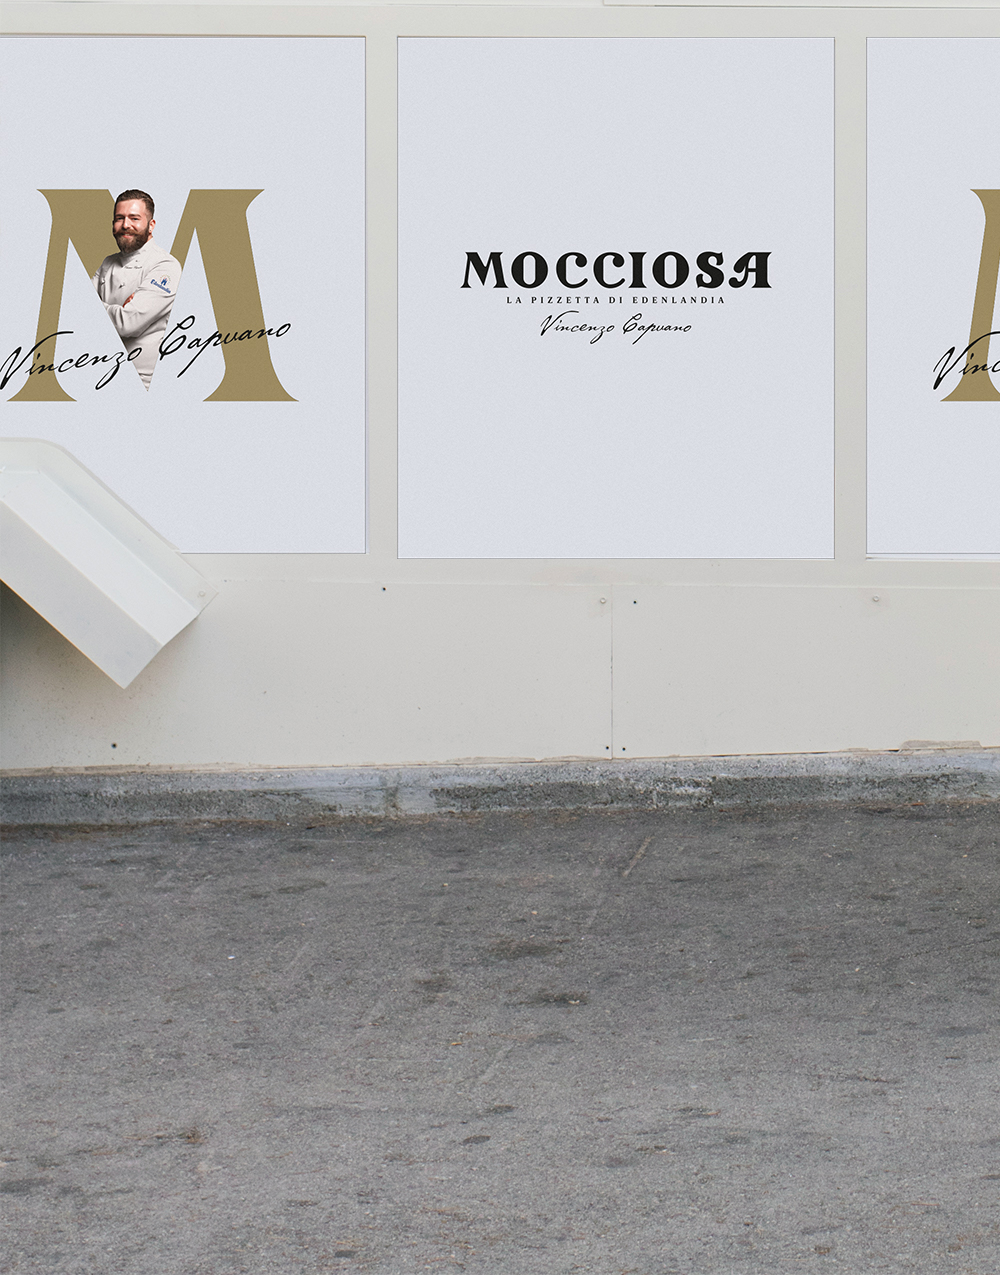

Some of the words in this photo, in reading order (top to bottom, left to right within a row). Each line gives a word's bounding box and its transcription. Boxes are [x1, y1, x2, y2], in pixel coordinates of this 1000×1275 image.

[460, 251, 772, 289] MOCCIOSA
[506, 296, 522, 304] LA
[531, 296, 600, 304] PIZZETTA
[608, 296, 623, 304] DI
[632, 296, 725, 304] EDENLANDIA
[540, 310, 615, 345] Vincenzo
[622, 312, 692, 345] Capuano
[0, 331, 143, 390] Vincenzo
[159, 315, 291, 378] Capuano
